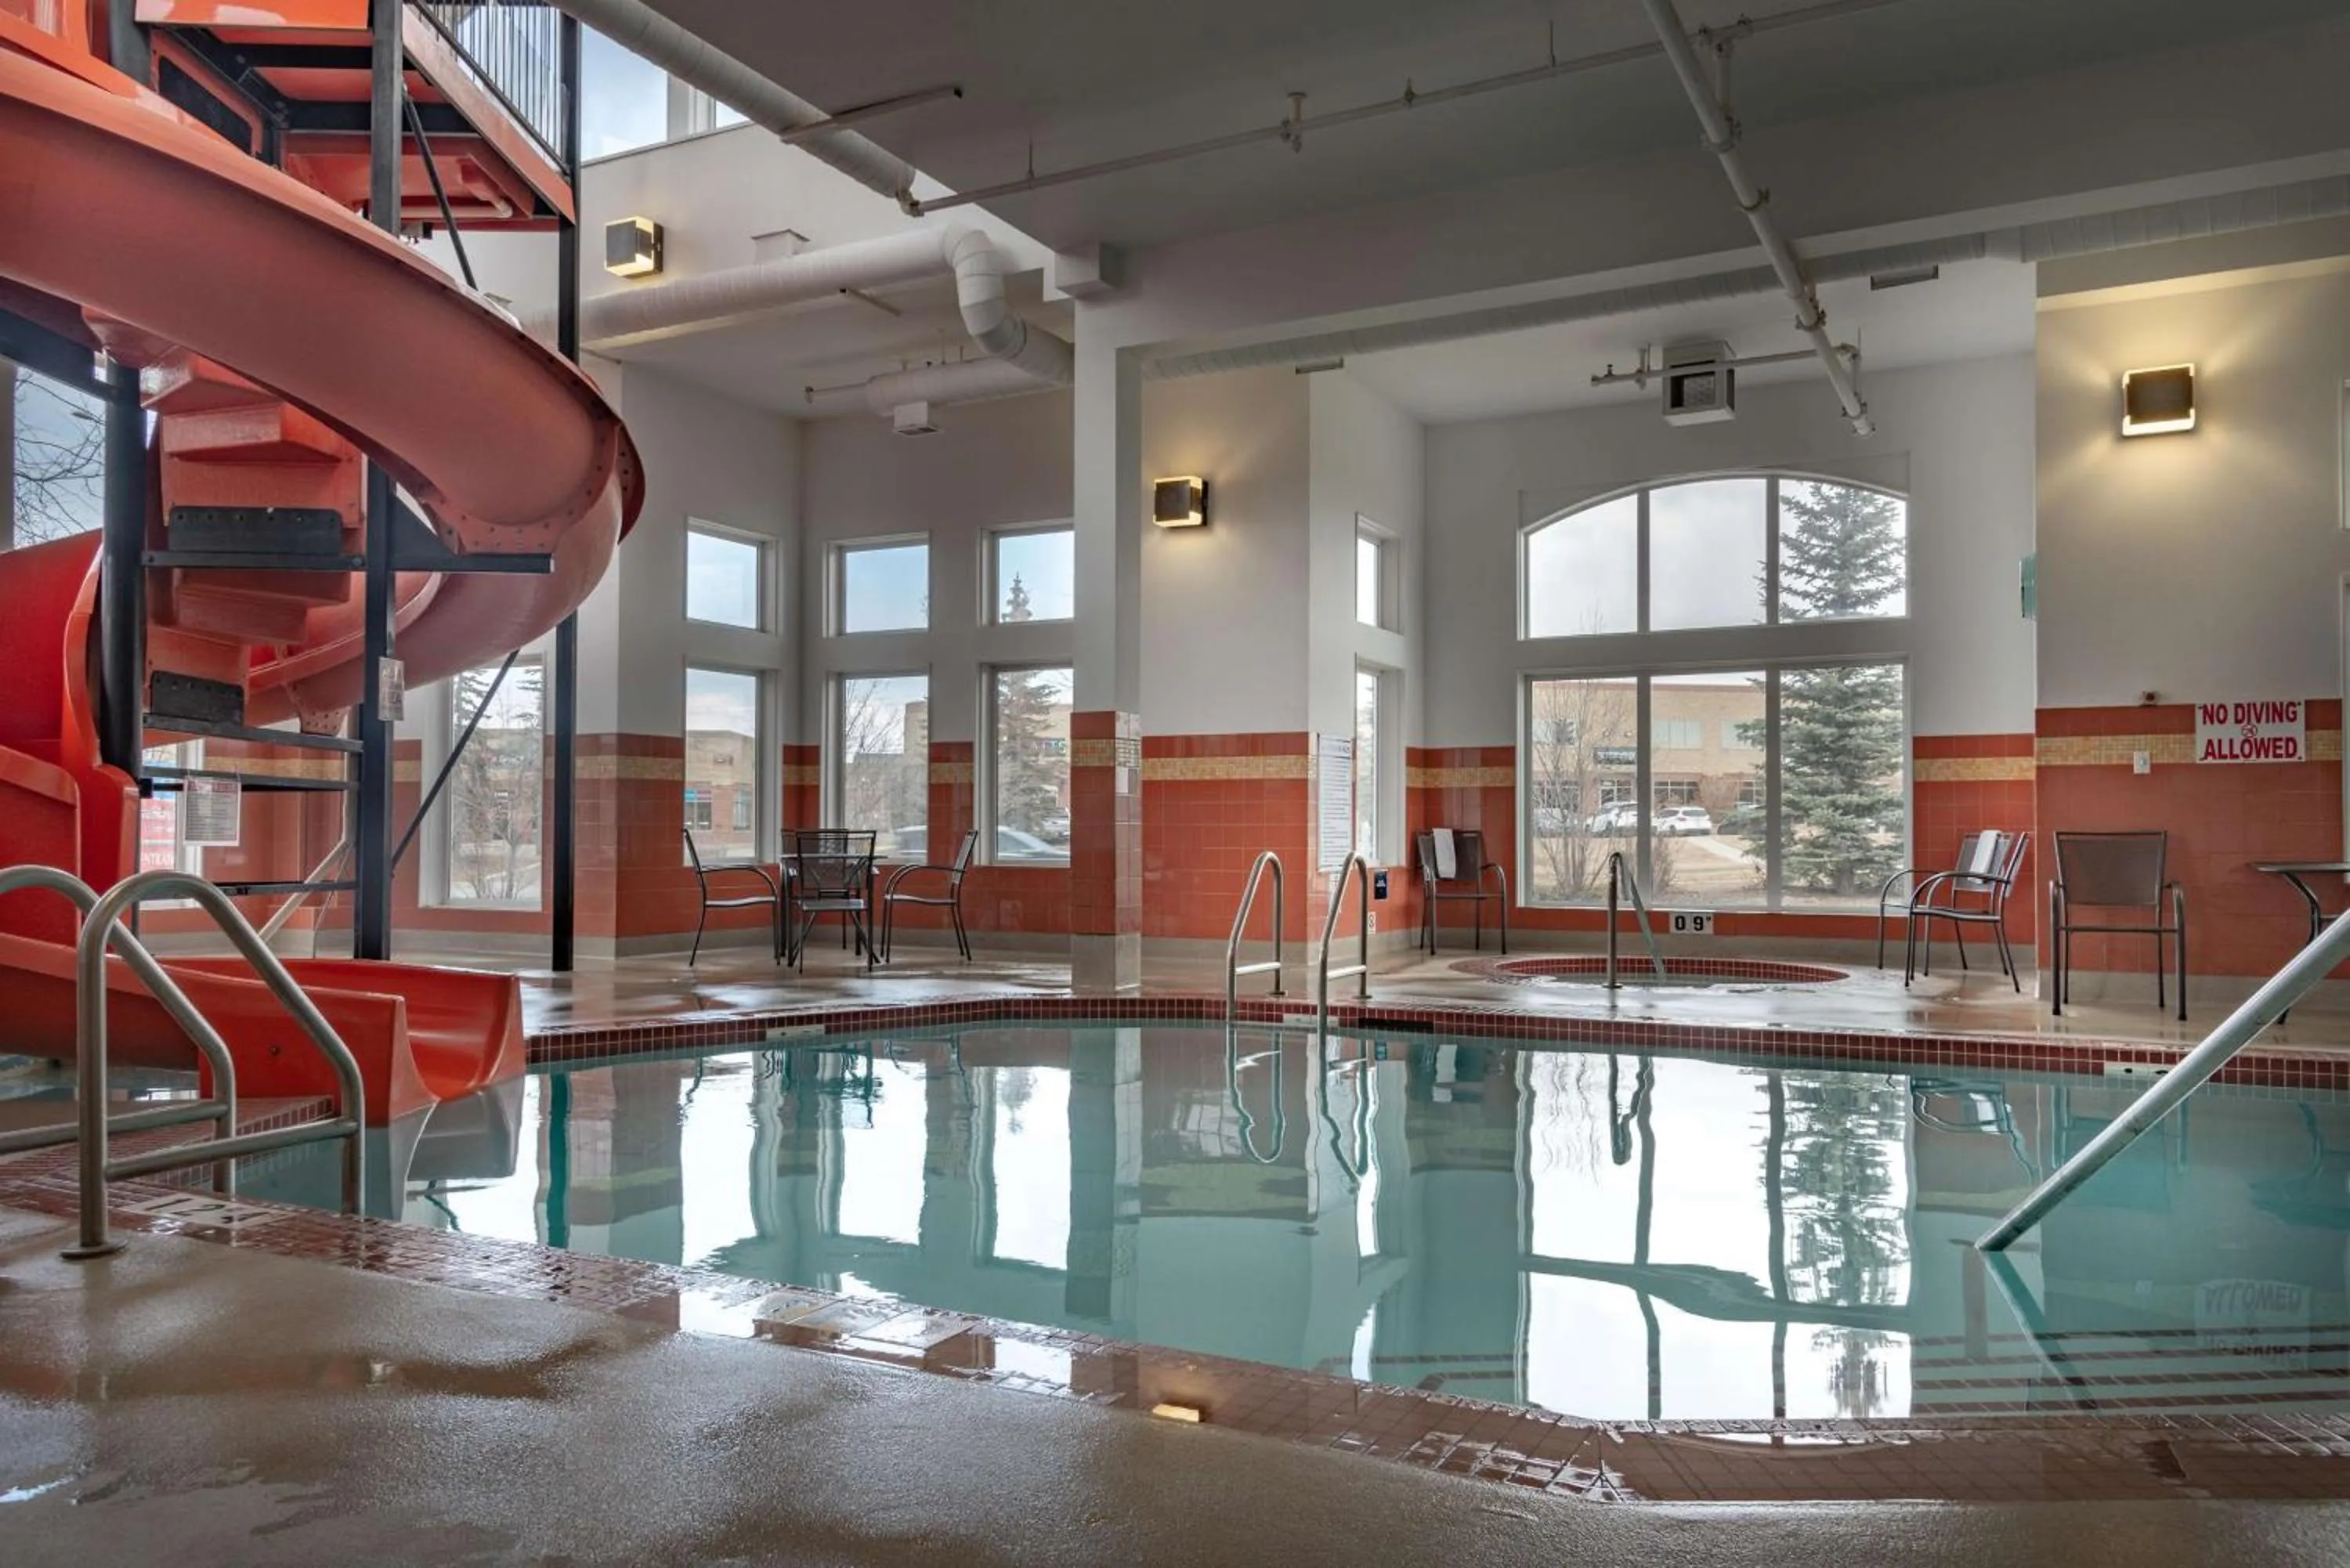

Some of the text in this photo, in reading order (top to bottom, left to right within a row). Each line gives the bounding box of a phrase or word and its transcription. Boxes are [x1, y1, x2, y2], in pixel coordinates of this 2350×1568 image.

[2202, 701, 2298, 725] NO DIVING
[2204, 736, 2298, 760] ALLOWED
